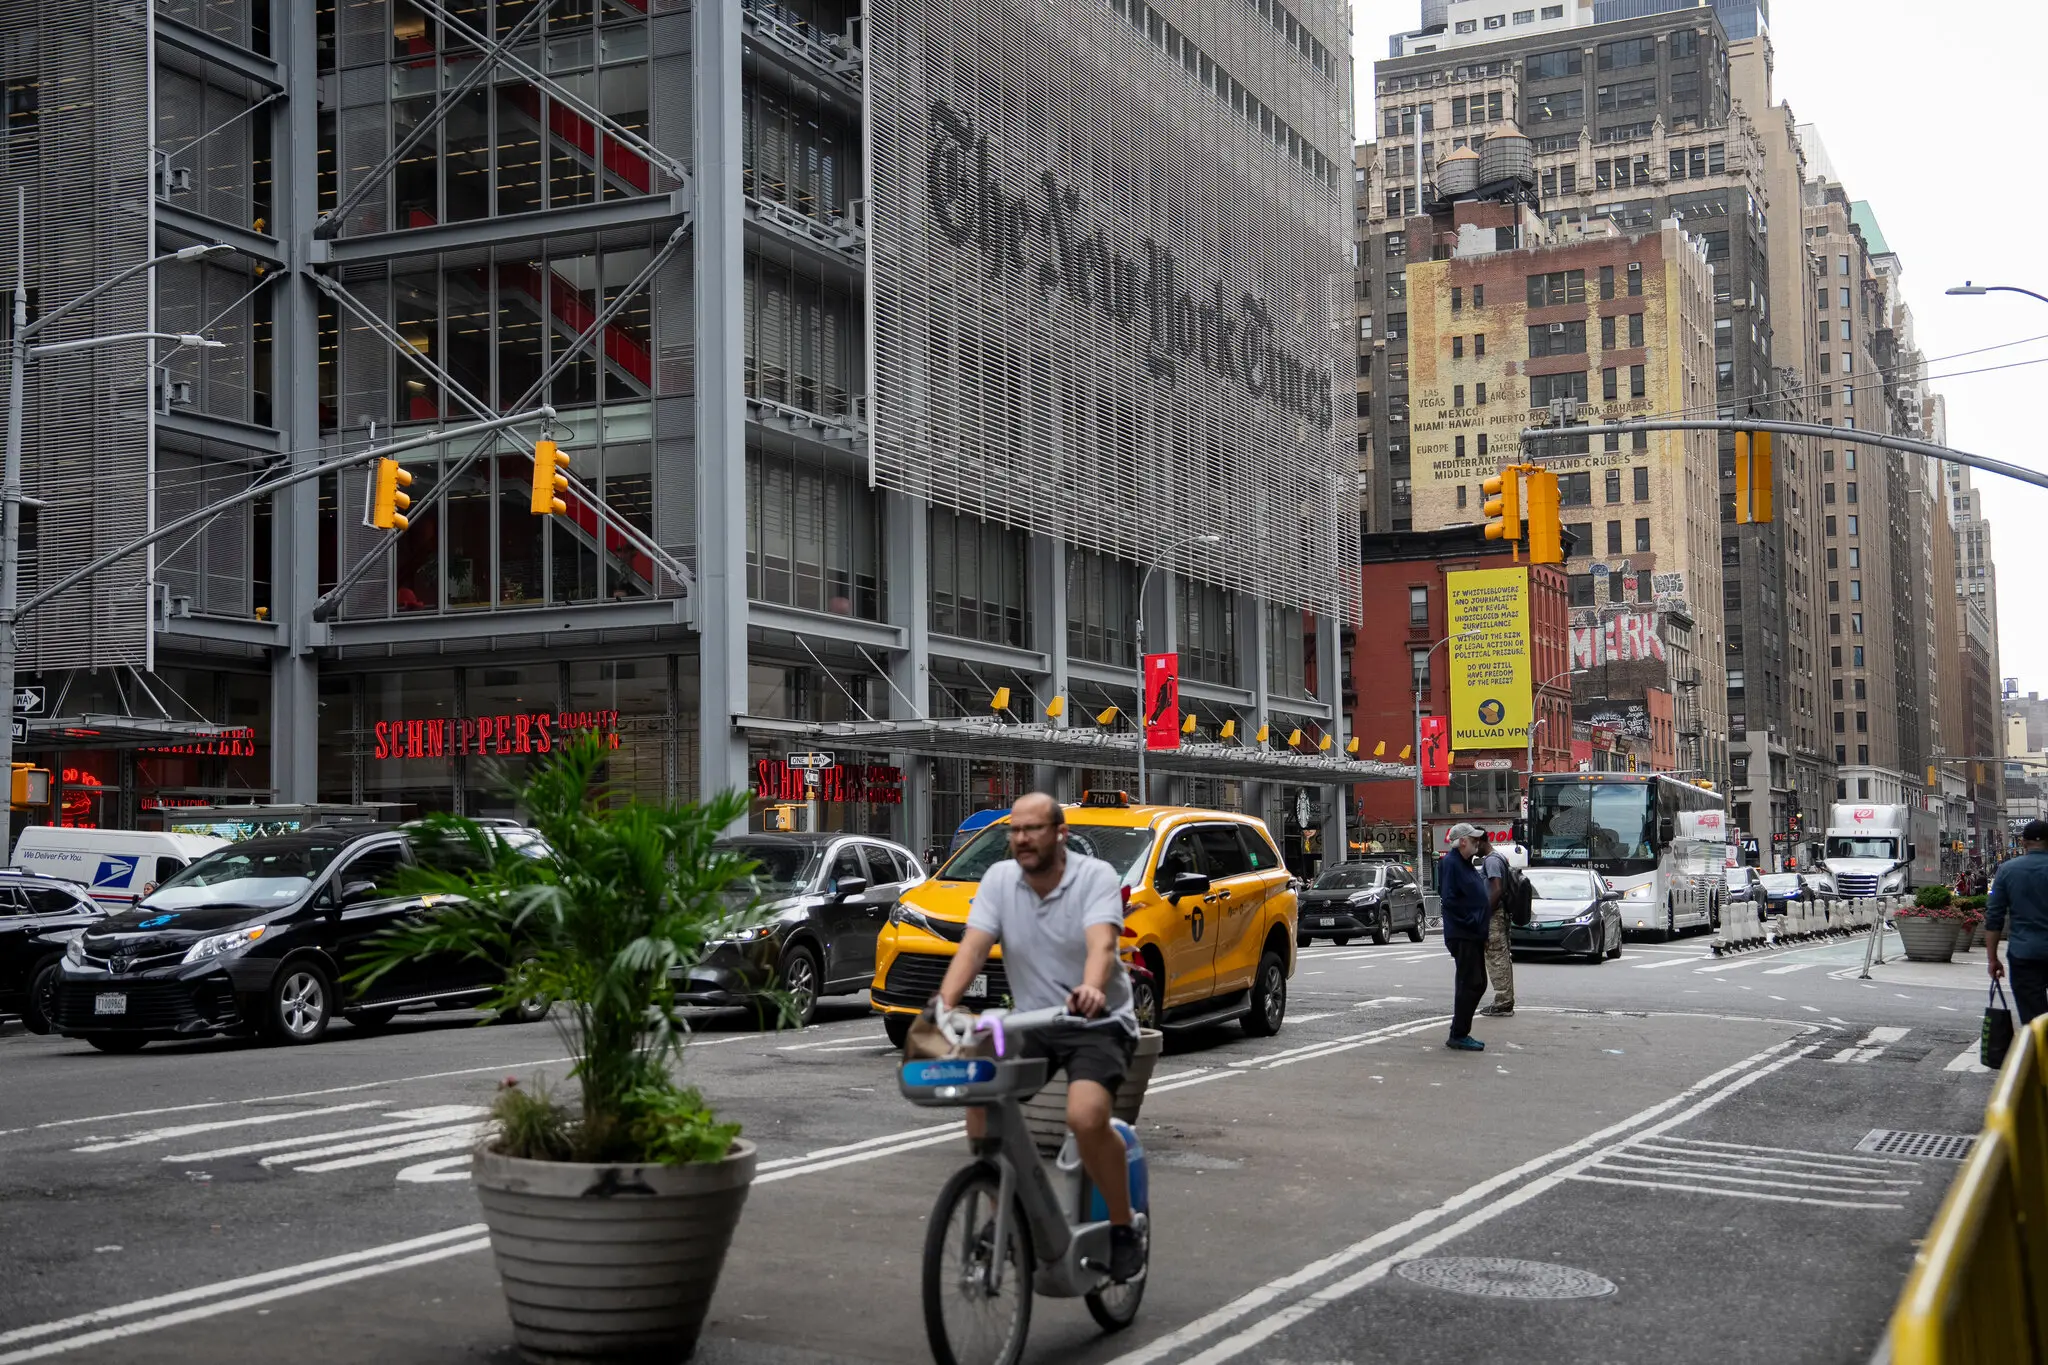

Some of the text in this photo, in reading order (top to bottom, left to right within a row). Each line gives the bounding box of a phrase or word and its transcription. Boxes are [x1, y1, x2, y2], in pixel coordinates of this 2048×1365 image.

[1418, 398, 1446, 408] VEGAS
[1438, 407, 1479, 419] MEXICO
[1414, 422, 1444, 432] MIAMI
[1448, 418, 1485, 429] HAWAII
[1490, 413, 1526, 425] PUERTO
[1416, 443, 1449, 455] EUROPE
[1435, 469, 1471, 480] MIDDLE
[1462, 586, 1519, 597] WHISTLEBLOWERS
[1455, 612, 1499, 622] UNDISCLOSED
[1462, 620, 1511, 630] SURVEILLANCE
[1457, 633, 1489, 642] WITHOUT
[1464, 642, 1484, 650] LEGAL
[1486, 641, 1513, 649] ACTION
[1455, 650, 1491, 659] POLITICAL
[1478, 662, 1491, 670] YOU
[1467, 671, 1483, 679] HAVE
[16, 695, 34, 705] WAY
[375, 710, 619, 759] SCHNIPPER'S QUALITY
[1456, 727, 1528, 739] MULLVAD VPN
[1093, 793, 1116, 804] 7H70
[23, 851, 35, 859] We
[34, 852, 59, 860] Deliver
